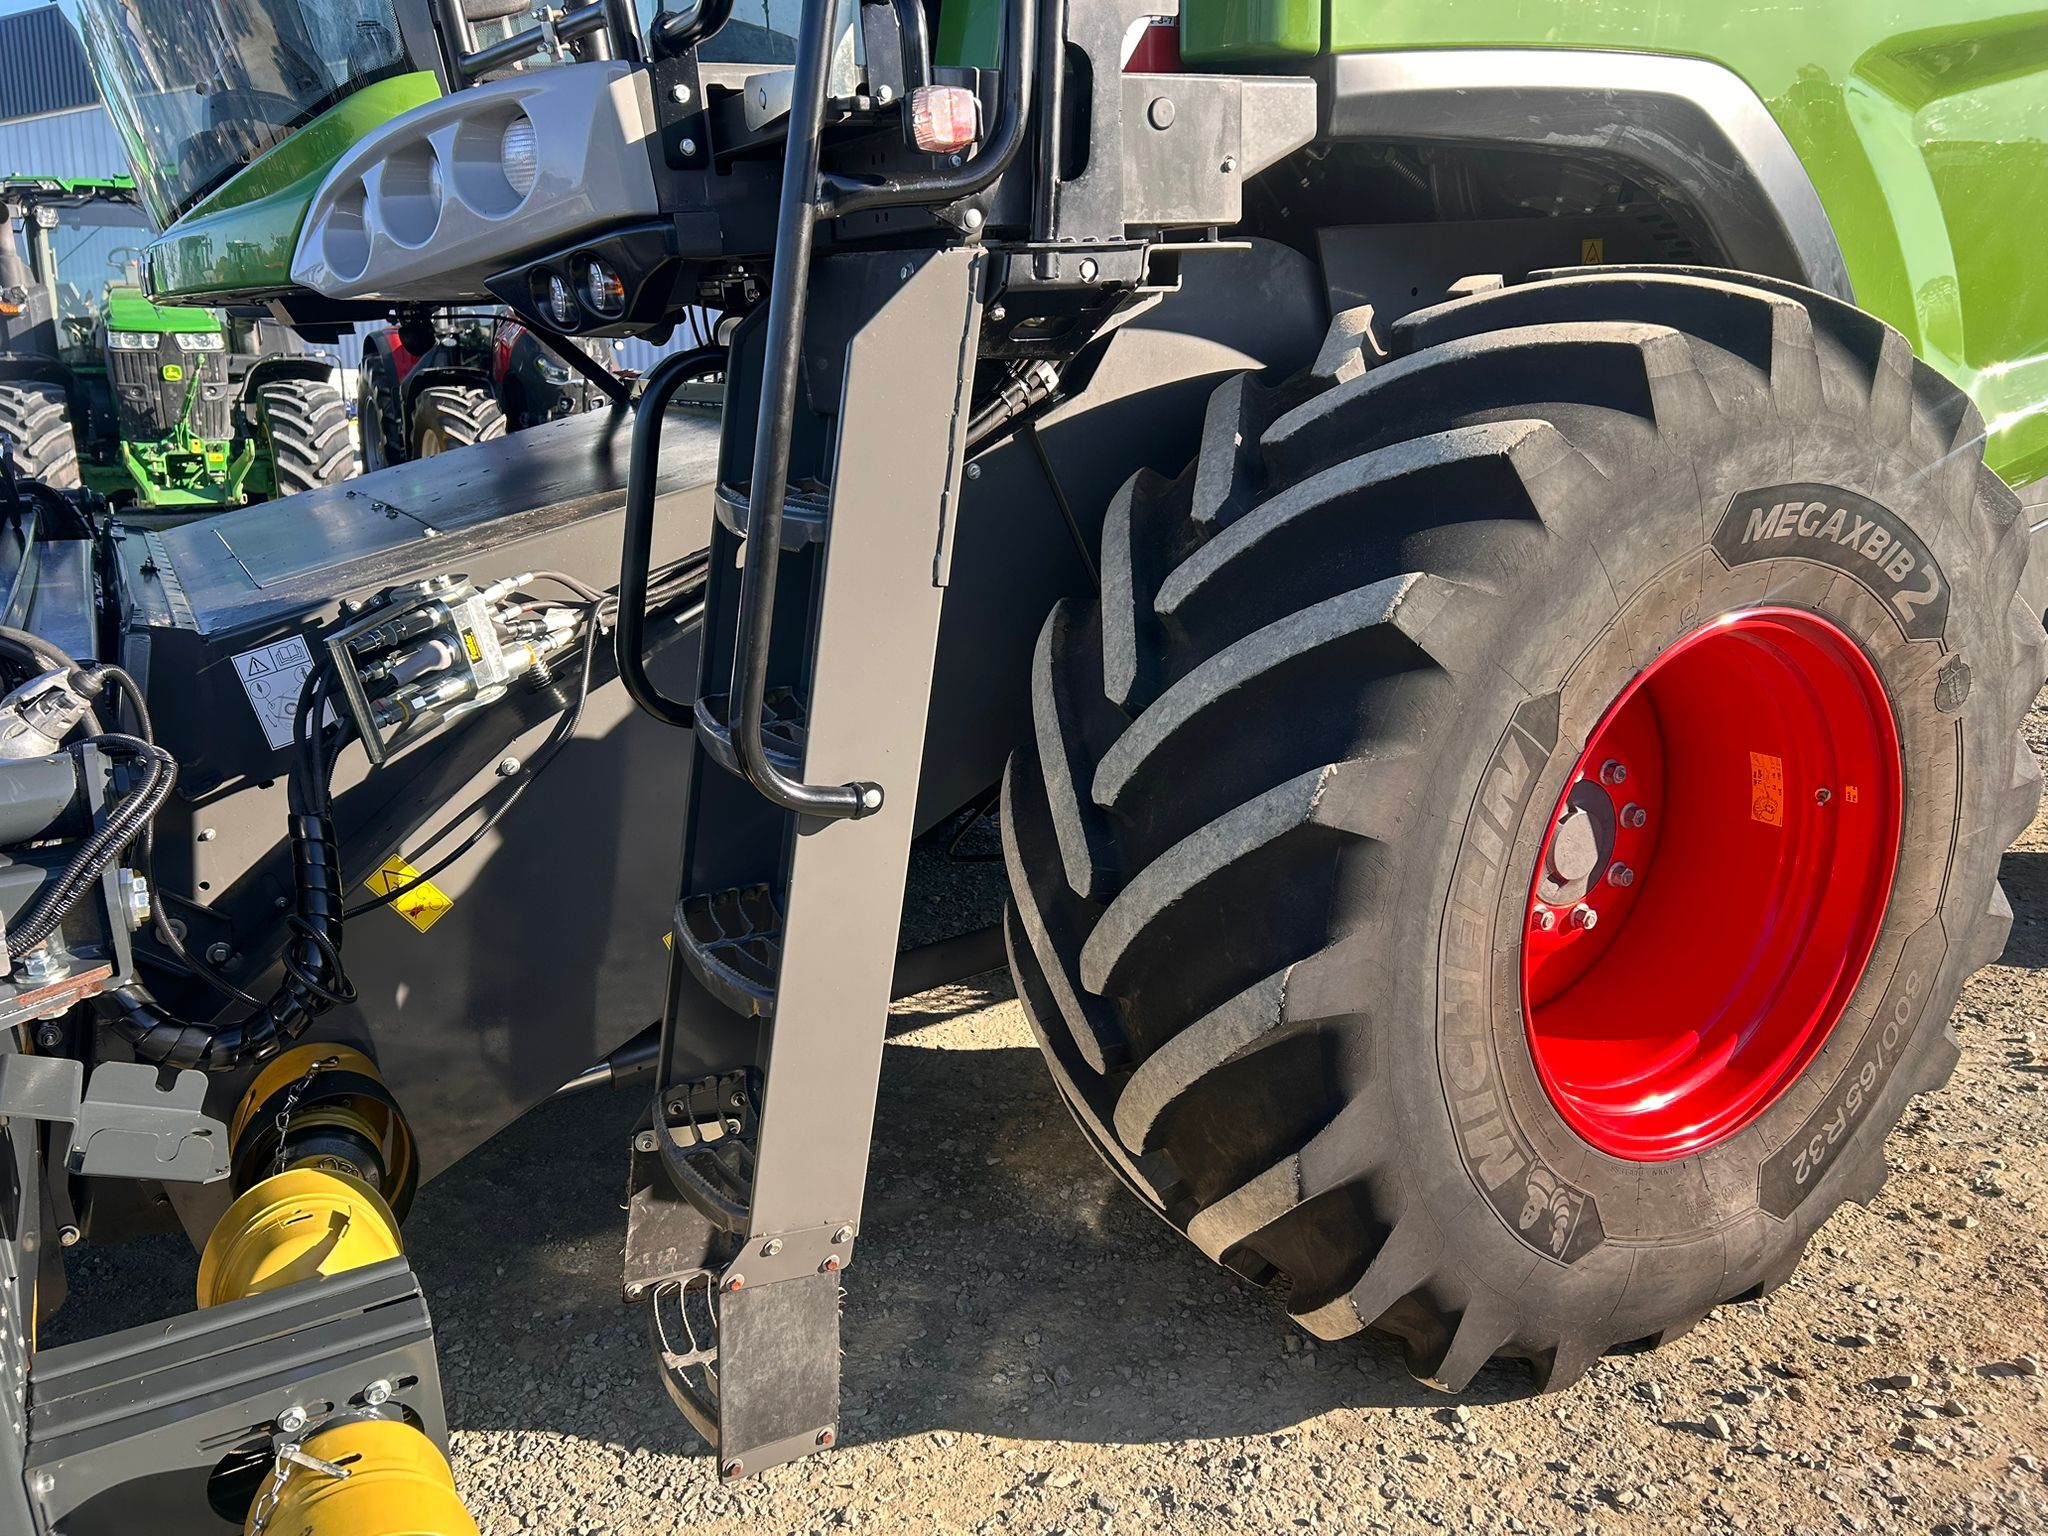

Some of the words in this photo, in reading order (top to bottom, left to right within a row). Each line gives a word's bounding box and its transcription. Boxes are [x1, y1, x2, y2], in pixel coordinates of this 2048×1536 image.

[1741, 502, 1916, 583] MEGAXBIB
[1891, 564, 1940, 624] 2
[1444, 734, 1531, 1192] MICHELIN
[1792, 970, 1921, 1185] 800/65R32
